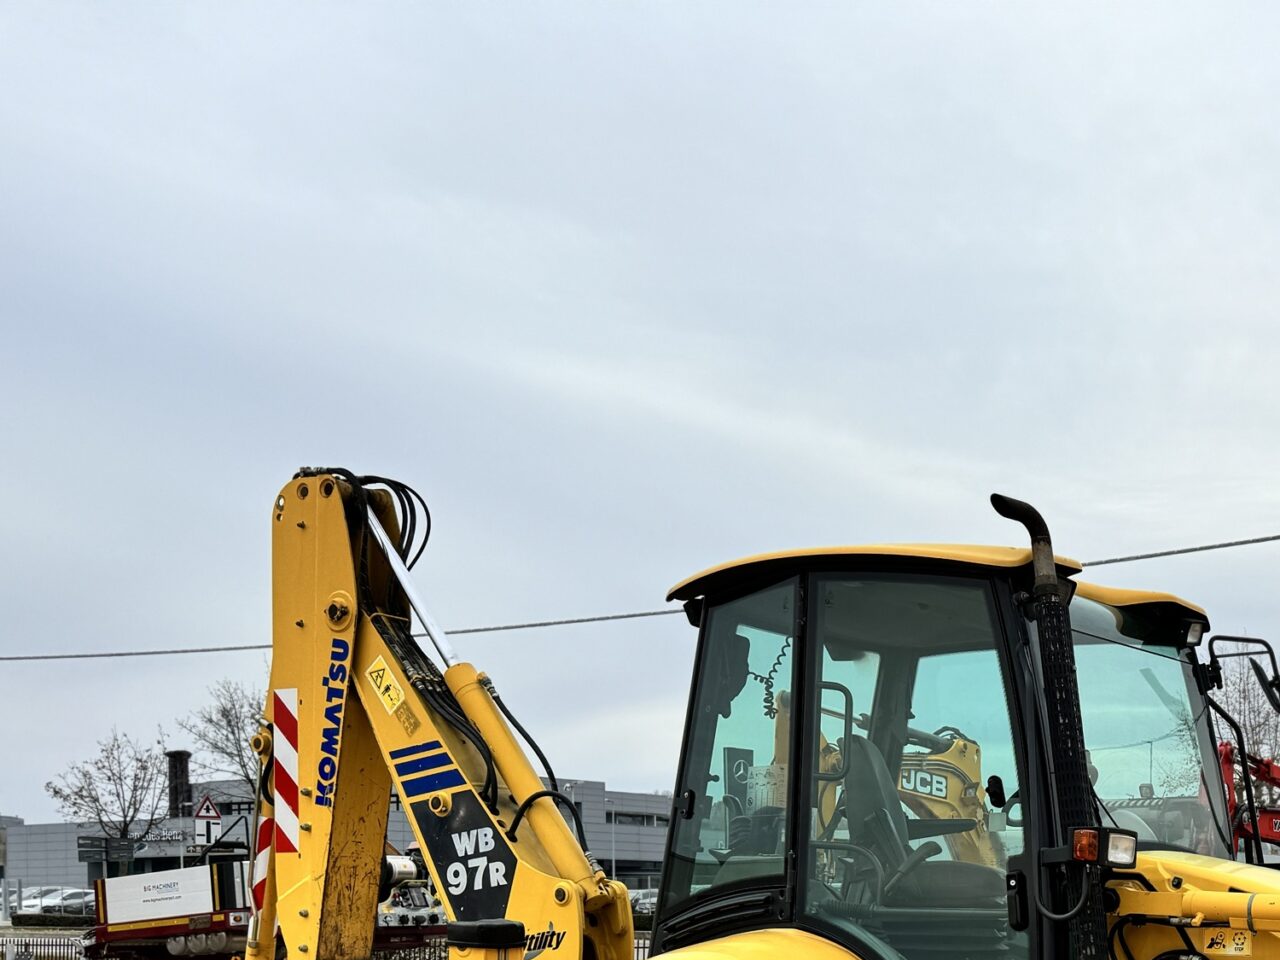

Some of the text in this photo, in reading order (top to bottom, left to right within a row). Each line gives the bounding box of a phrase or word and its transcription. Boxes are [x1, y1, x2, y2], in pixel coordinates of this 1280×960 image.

[315, 638, 350, 807] KOMATSU
[902, 769, 946, 797] JCB
[451, 827, 495, 857] WB
[446, 856, 508, 895] 97R
